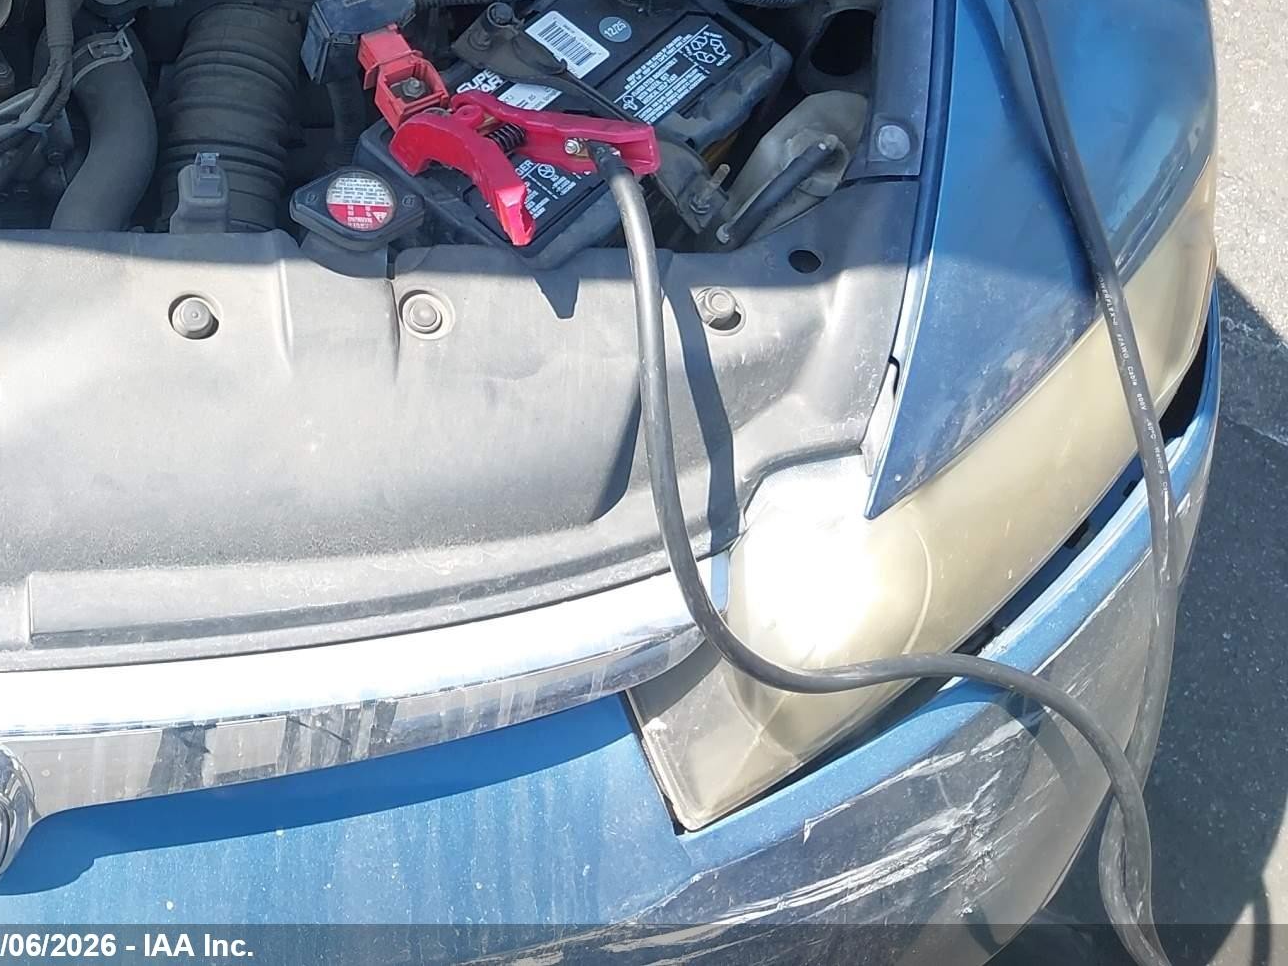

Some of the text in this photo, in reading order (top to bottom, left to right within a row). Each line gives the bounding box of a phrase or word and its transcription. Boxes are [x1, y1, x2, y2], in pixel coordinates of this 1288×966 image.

[604, 22, 627, 38] 12/25
[456, 69, 494, 94] SUPE
[1127, 365, 1138, 386] Cable
